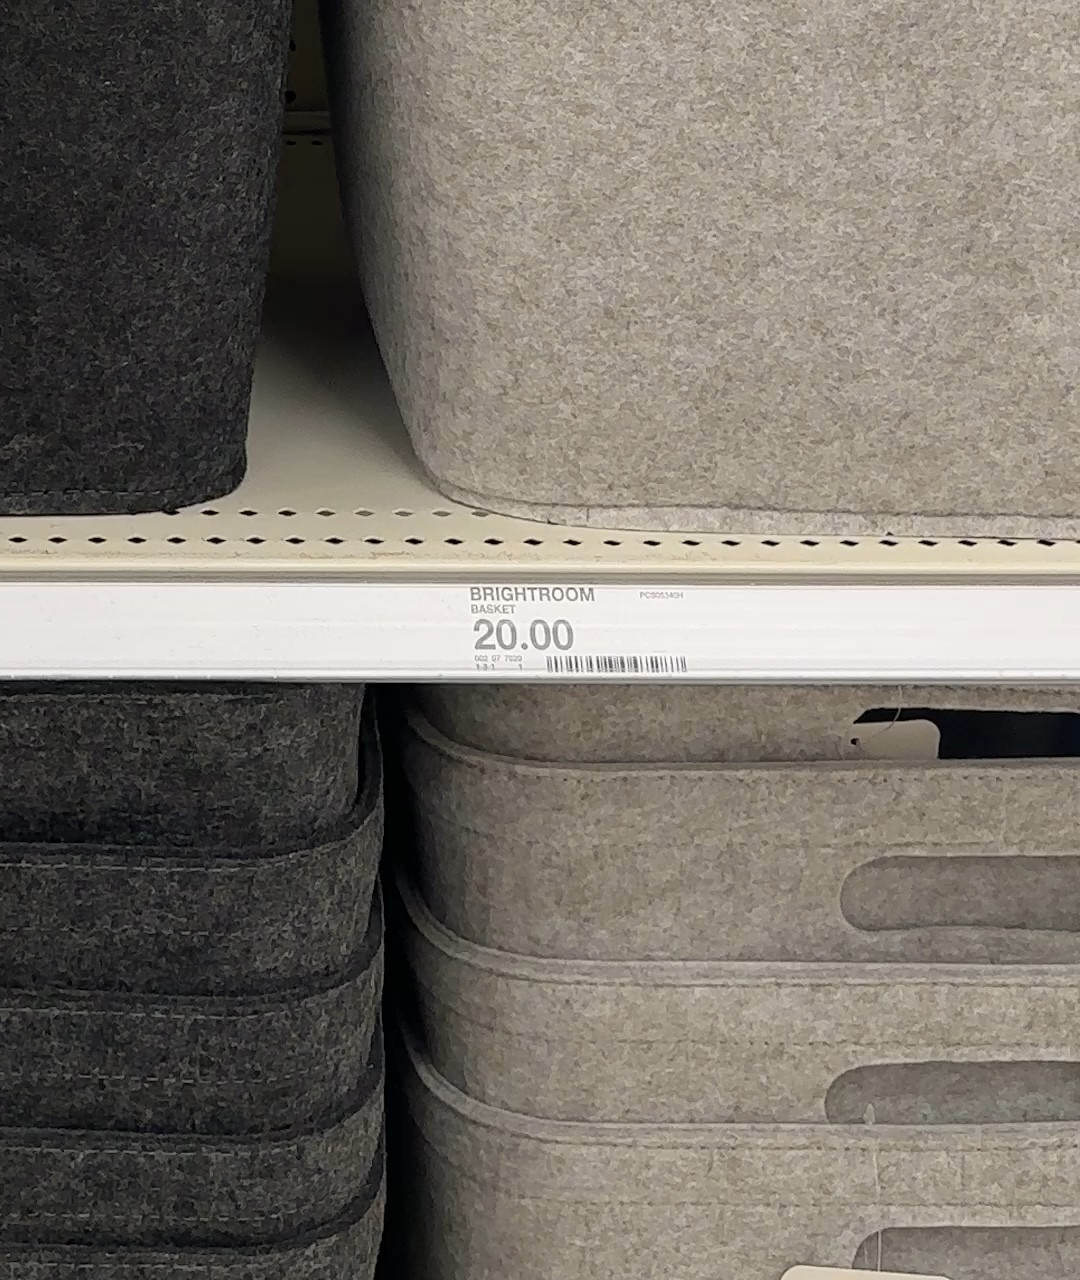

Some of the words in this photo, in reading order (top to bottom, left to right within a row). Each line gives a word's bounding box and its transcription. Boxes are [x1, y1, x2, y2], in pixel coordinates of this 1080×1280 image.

[471, 587, 595, 602] BRIGHTROOM
[471, 604, 516, 614] BASKET
[473, 619, 574, 650] 20.00
